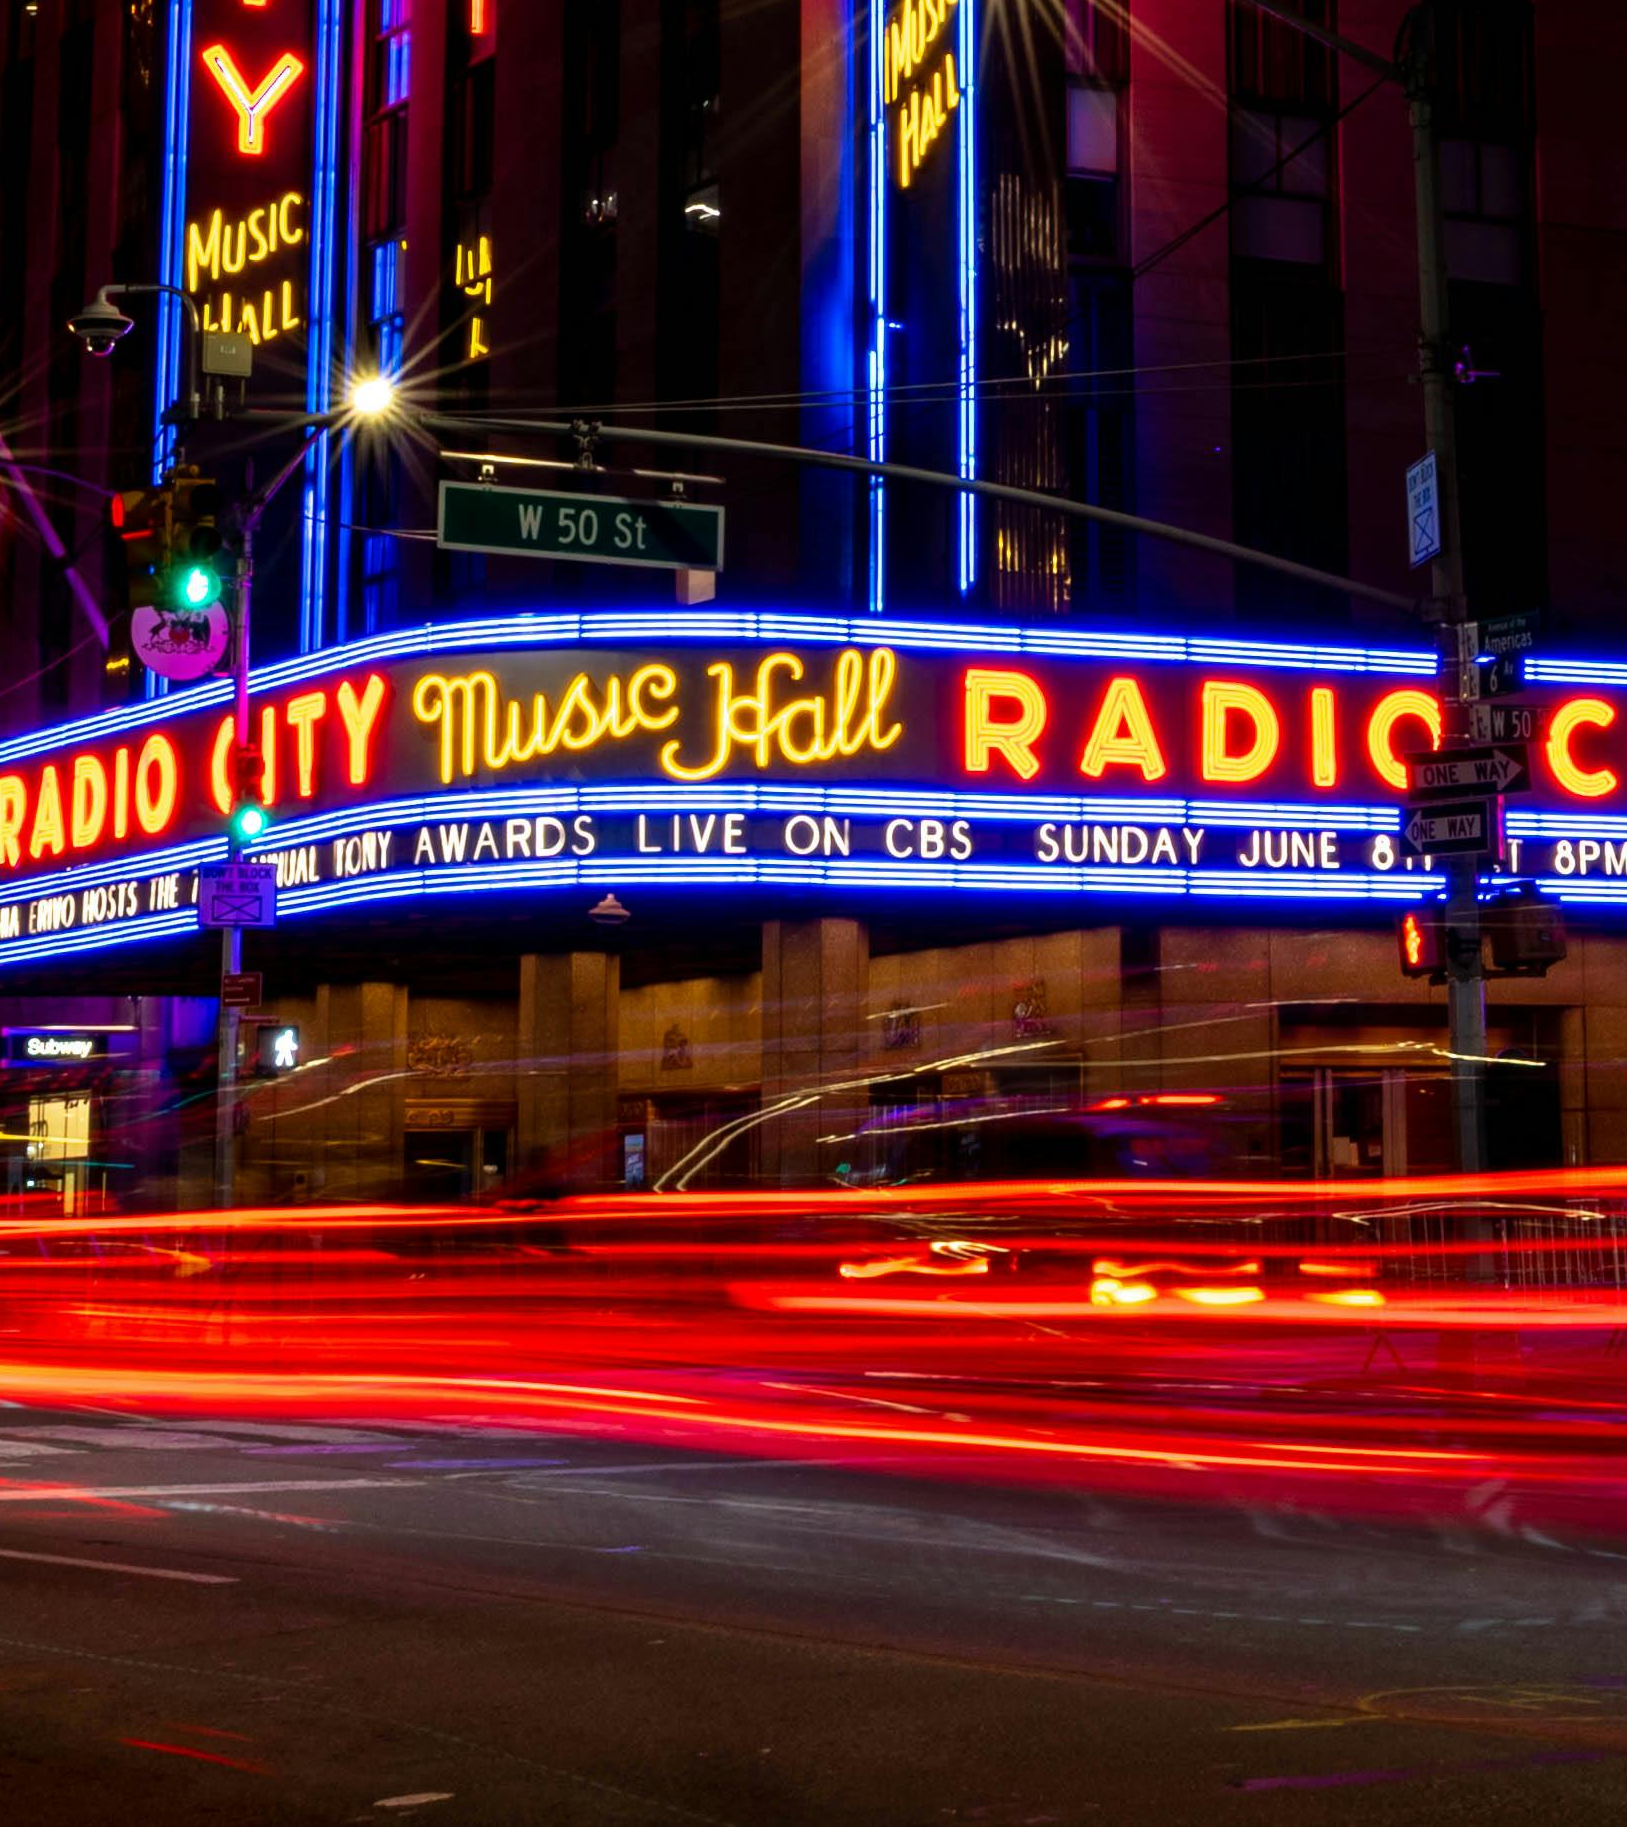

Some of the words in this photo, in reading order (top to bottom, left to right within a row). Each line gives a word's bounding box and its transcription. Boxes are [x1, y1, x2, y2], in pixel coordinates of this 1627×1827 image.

[899, 52, 959, 189] HALL
[187, 190, 304, 292] MUSIC
[518, 505, 543, 540] W
[557, 508, 598, 546] 50
[614, 513, 647, 550] St
[1484, 631, 1533, 654] Americas
[1489, 664, 1498, 693] 6
[211, 672, 386, 815] CITY
[412, 662, 680, 784] Music
[661, 645, 903, 781] Hall
[962, 668, 1441, 791] RADIO
[1492, 711, 1505, 738] W
[1512, 710, 1532, 739] 50
[1422, 764, 1460, 786] ONE
[1474, 760, 1510, 782] WAY
[1412, 819, 1436, 841] ONE
[1447, 816, 1475, 837] WAY
[28, 892, 75, 934] ERIVO
[83, 880, 138, 924] HOSTS
[149, 872, 179, 911] THE
[334, 830, 392, 876] TONY
[414, 815, 595, 864] AWARDS
[638, 813, 748, 854] LIVE
[784, 815, 851, 857] ON
[885, 818, 973, 861] CBS
[1037, 823, 1204, 866] SUNDAY
[1239, 830, 1338, 870] JUNE
[215, 880, 235, 894] THE
[27, 1037, 93, 1059] Subway
